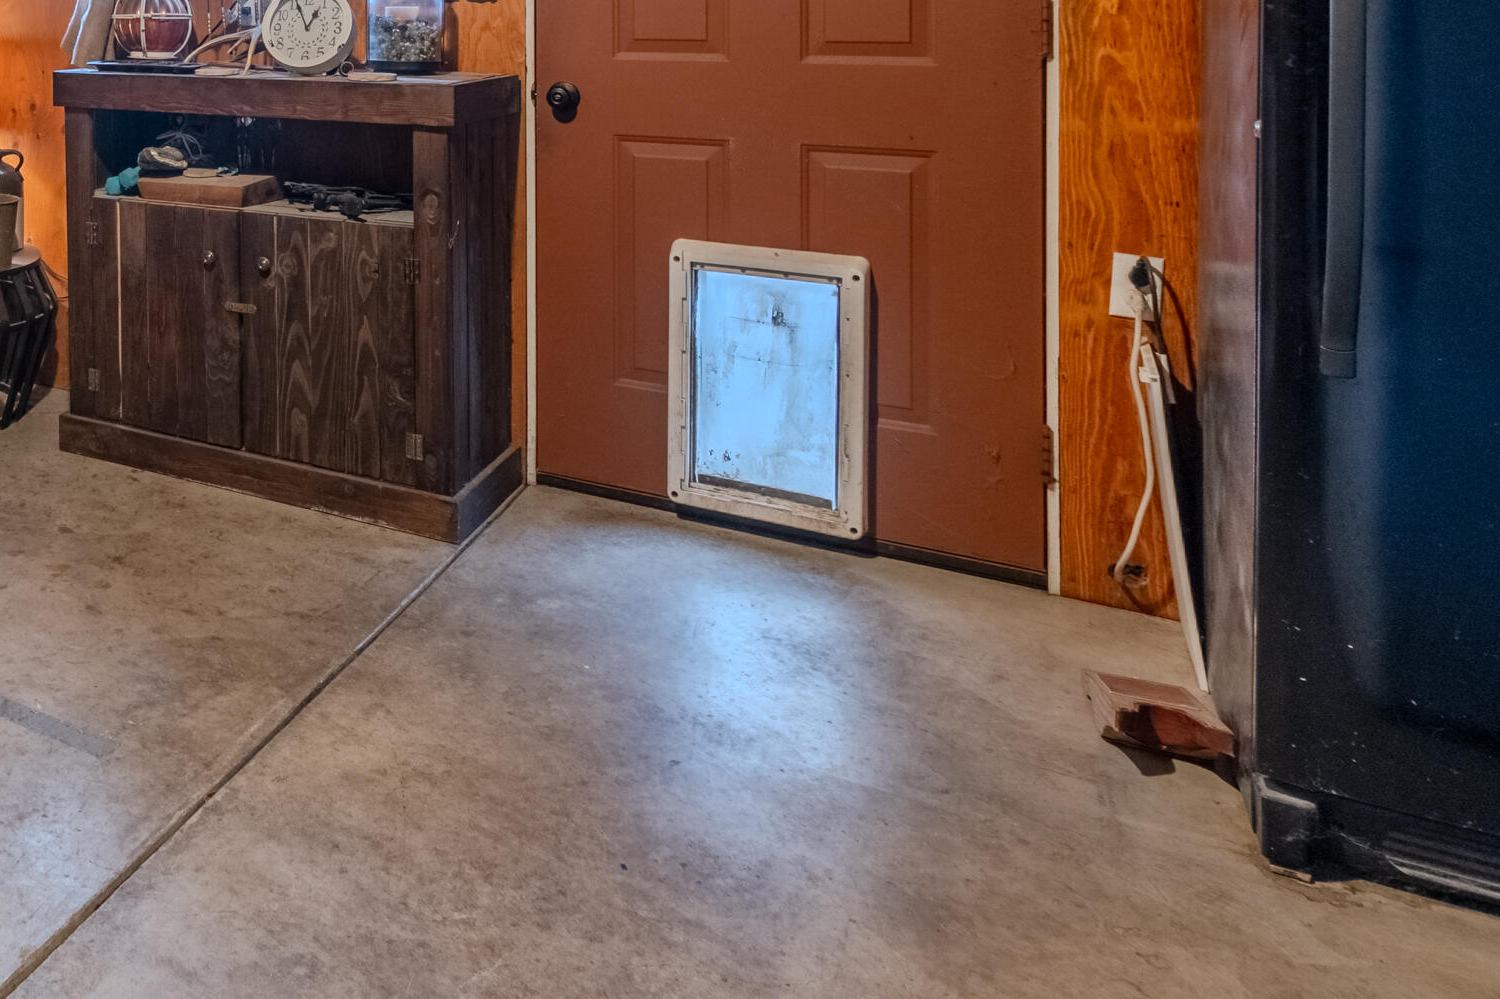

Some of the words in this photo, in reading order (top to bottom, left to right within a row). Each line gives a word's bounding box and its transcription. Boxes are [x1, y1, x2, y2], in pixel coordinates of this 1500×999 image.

[278, 10, 289, 21] 10
[331, 6, 341, 20] 2
[273, 22, 282, 36] 9
[333, 21, 342, 35] 3
[275, 37, 284, 50] 8
[328, 36, 336, 47] 4
[300, 50, 310, 61] 6
[316, 47, 325, 58] 5
